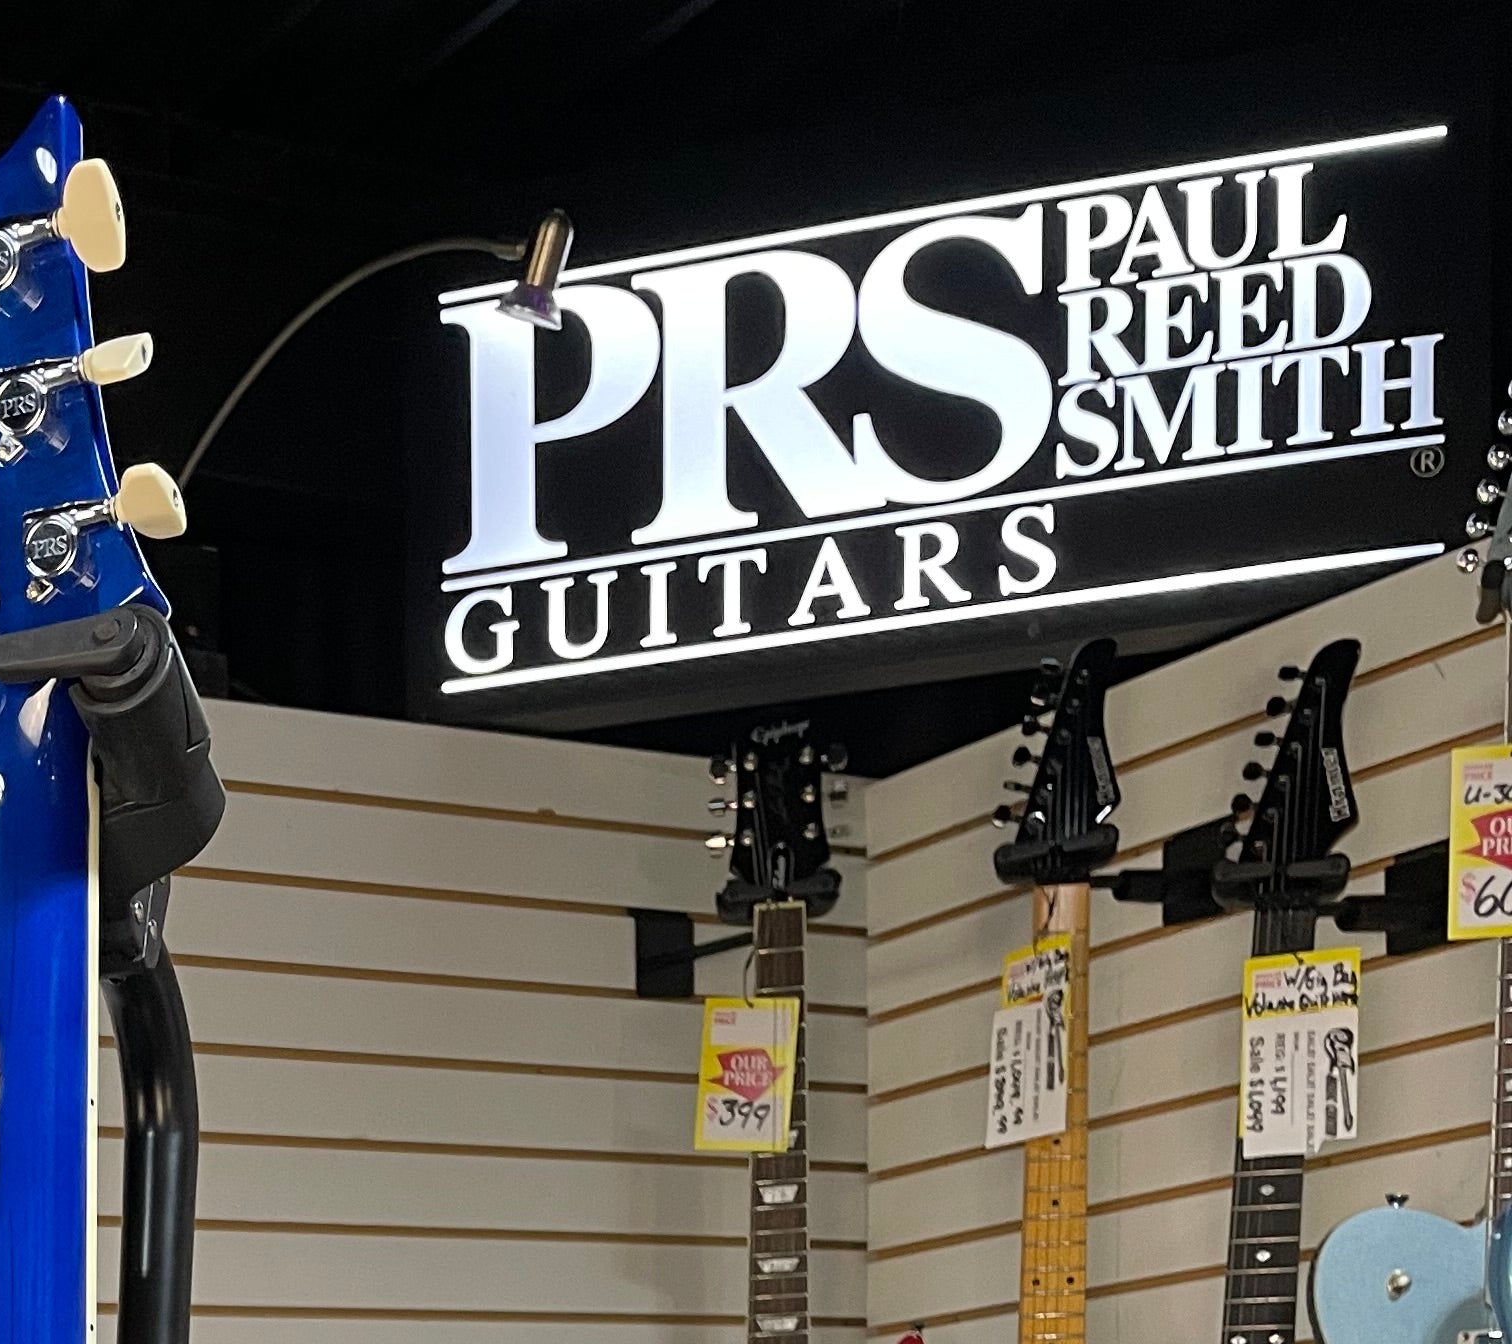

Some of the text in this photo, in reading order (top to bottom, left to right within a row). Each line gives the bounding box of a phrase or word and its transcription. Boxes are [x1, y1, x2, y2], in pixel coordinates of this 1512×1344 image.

[1056, 163, 1347, 293] PAUL
[1058, 253, 1372, 387] REED
[1, 393, 36, 419] PRS
[441, 203, 1053, 575] PRS
[1056, 333, 1445, 479] SMITH
[31, 535, 68, 560] PRS
[444, 503, 1058, 675] GUITARS
[724, 1071, 774, 1087] PRICE
[730, 1054, 769, 1072] OUR
